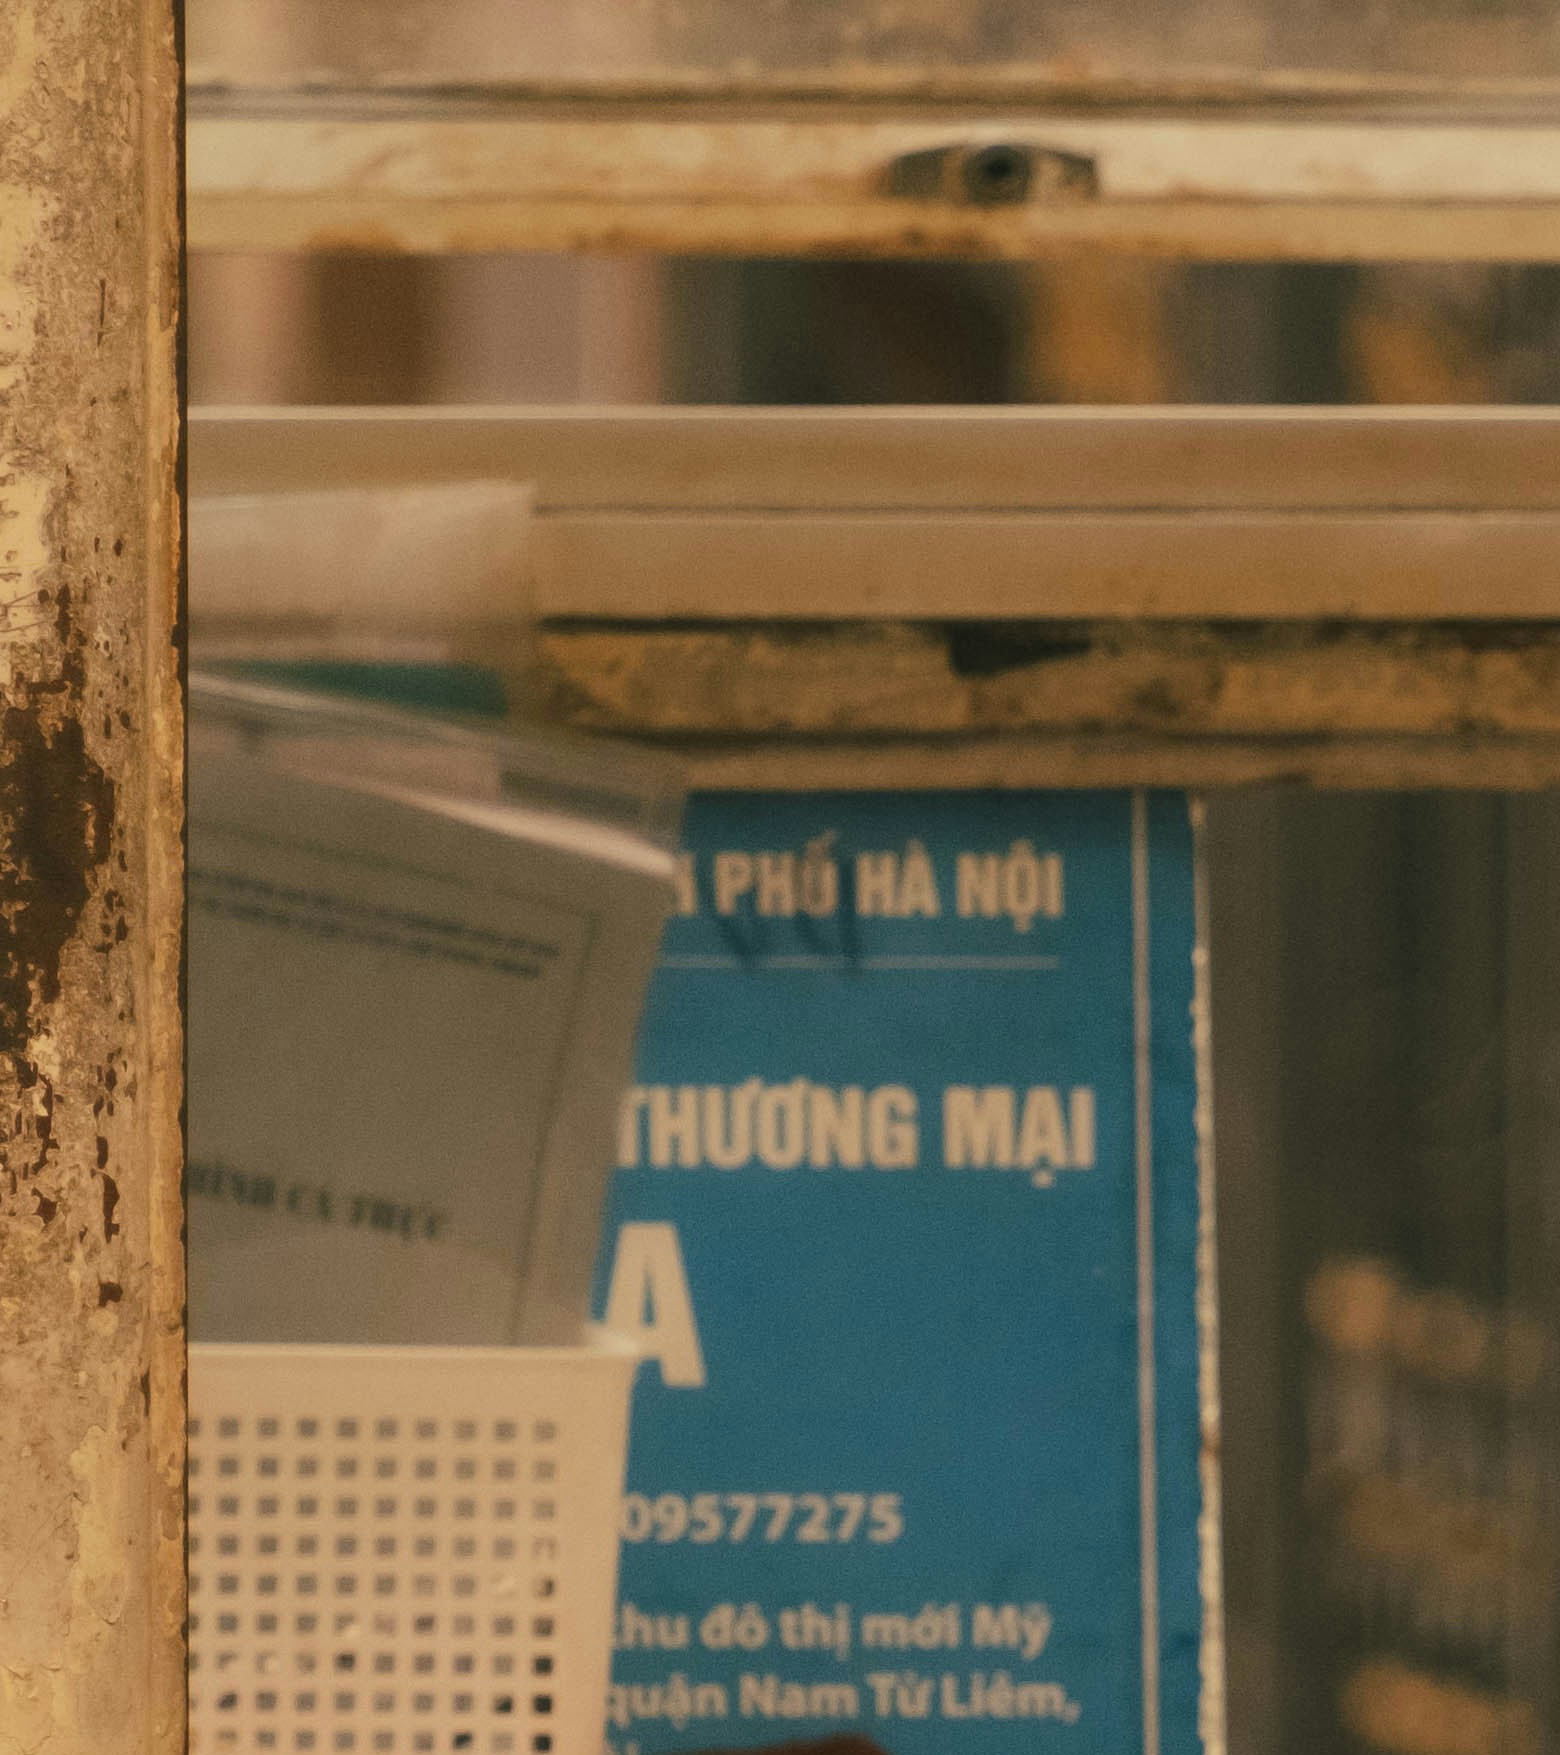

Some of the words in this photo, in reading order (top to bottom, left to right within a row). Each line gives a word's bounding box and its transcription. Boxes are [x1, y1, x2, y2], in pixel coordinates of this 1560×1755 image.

[714, 829, 837, 918] PHỐ
[855, 837, 938, 918] HÀ
[956, 838, 1065, 932] NỘI
[943, 1086, 1095, 1188] MẠI
[602, 1220, 706, 1388] A
[779, 1601, 851, 1663] thị
[861, 1601, 961, 1650] mới
[971, 1601, 1054, 1662] Mỹ
[740, 1673, 859, 1719] Nam
[866, 1669, 935, 1719] Từ
[942, 1668, 1081, 1726] Liêm,
